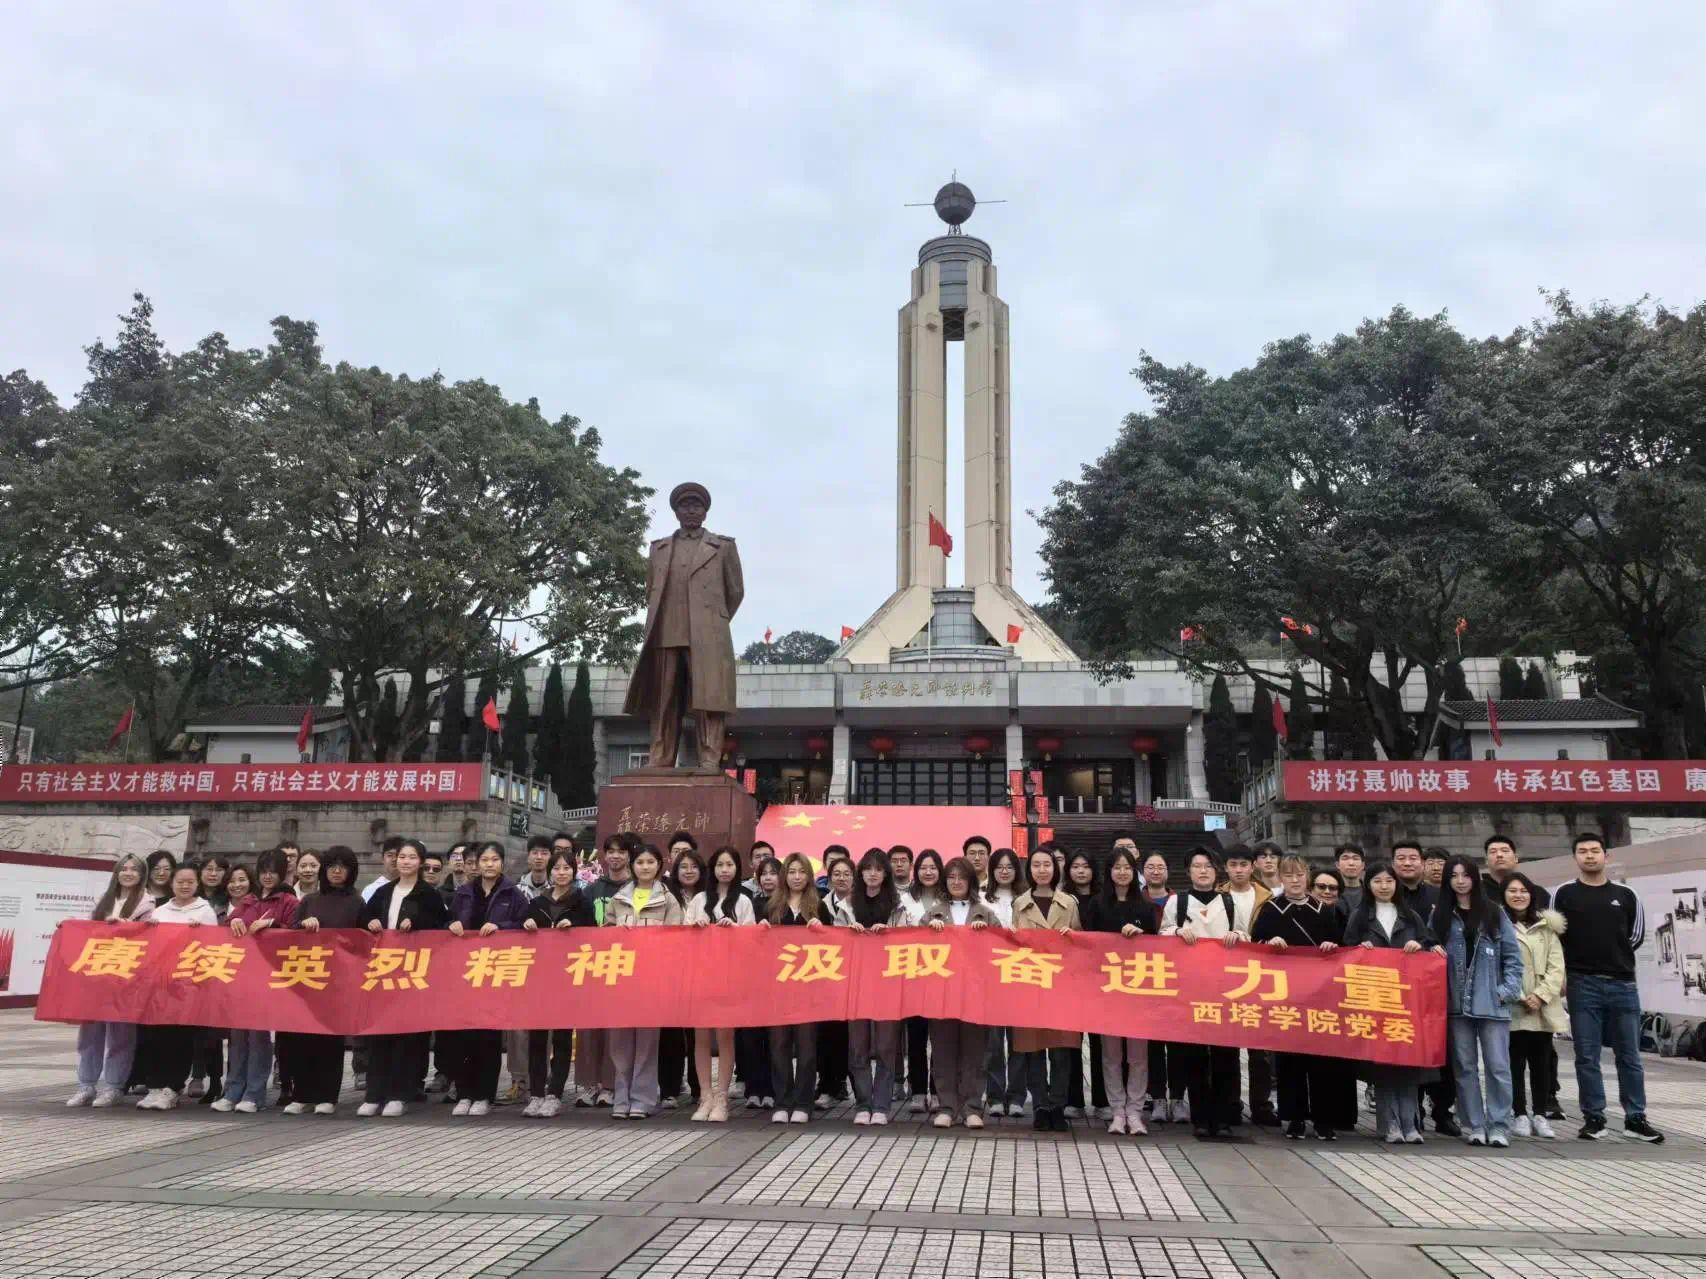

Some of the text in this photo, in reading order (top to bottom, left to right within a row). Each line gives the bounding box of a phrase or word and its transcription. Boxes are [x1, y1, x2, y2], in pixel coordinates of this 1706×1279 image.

[1307, 769, 1471, 793] 讲好聂帅故事
[1494, 769, 1661, 793] 传承红色基因
[68, 936, 1412, 1016] 赓续英烈精神 汲取奋进力量
[1190, 1001, 1417, 1045] 西塔学院党委
